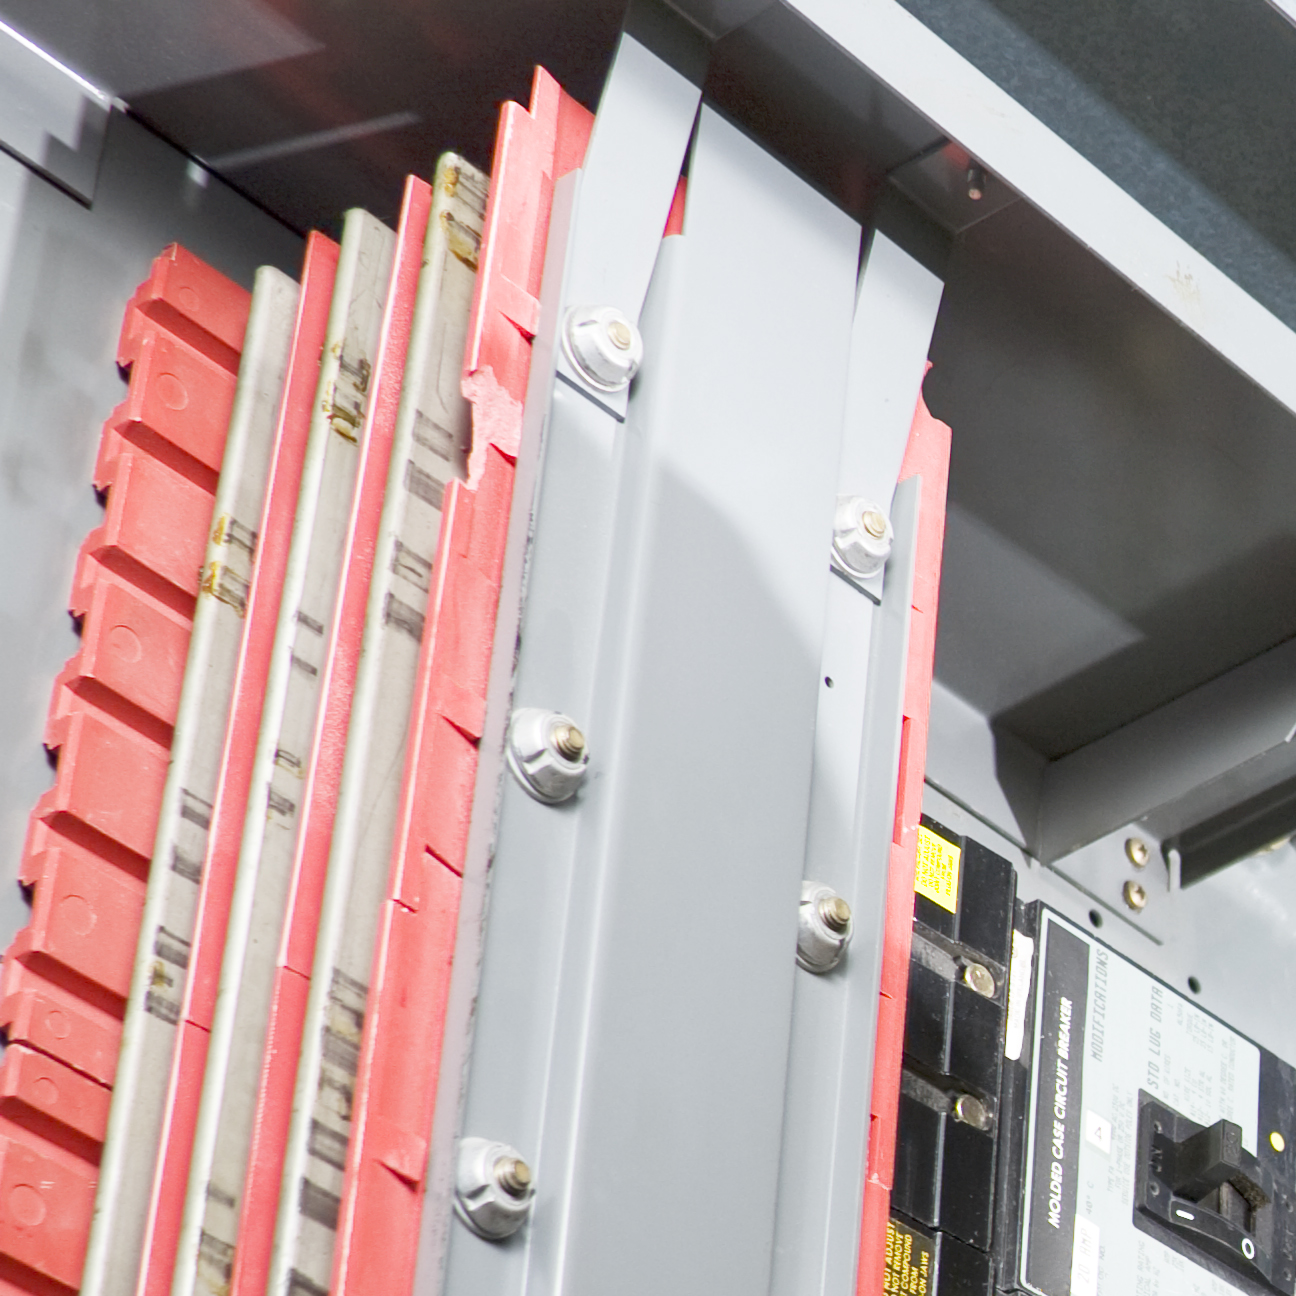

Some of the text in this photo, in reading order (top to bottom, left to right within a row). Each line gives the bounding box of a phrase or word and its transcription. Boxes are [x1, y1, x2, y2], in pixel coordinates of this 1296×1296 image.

[1090, 946, 1108, 1063] MODIFICATIONS
[1146, 984, 1162, 1090] STD LUG DATA
[1048, 994, 1072, 1229] MOLDED CASE CIRCUIT BREAKER
[885, 1222, 895, 1265] ADJUST
[893, 1230, 904, 1271] REMOVE
[901, 1234, 912, 1290] COMPOUND
[920, 1250, 930, 1277] JAWS
[1077, 1225, 1091, 1284] 20 AMP
[891, 1272, 900, 1293] NOT
[909, 1266, 919, 1294] FROM
